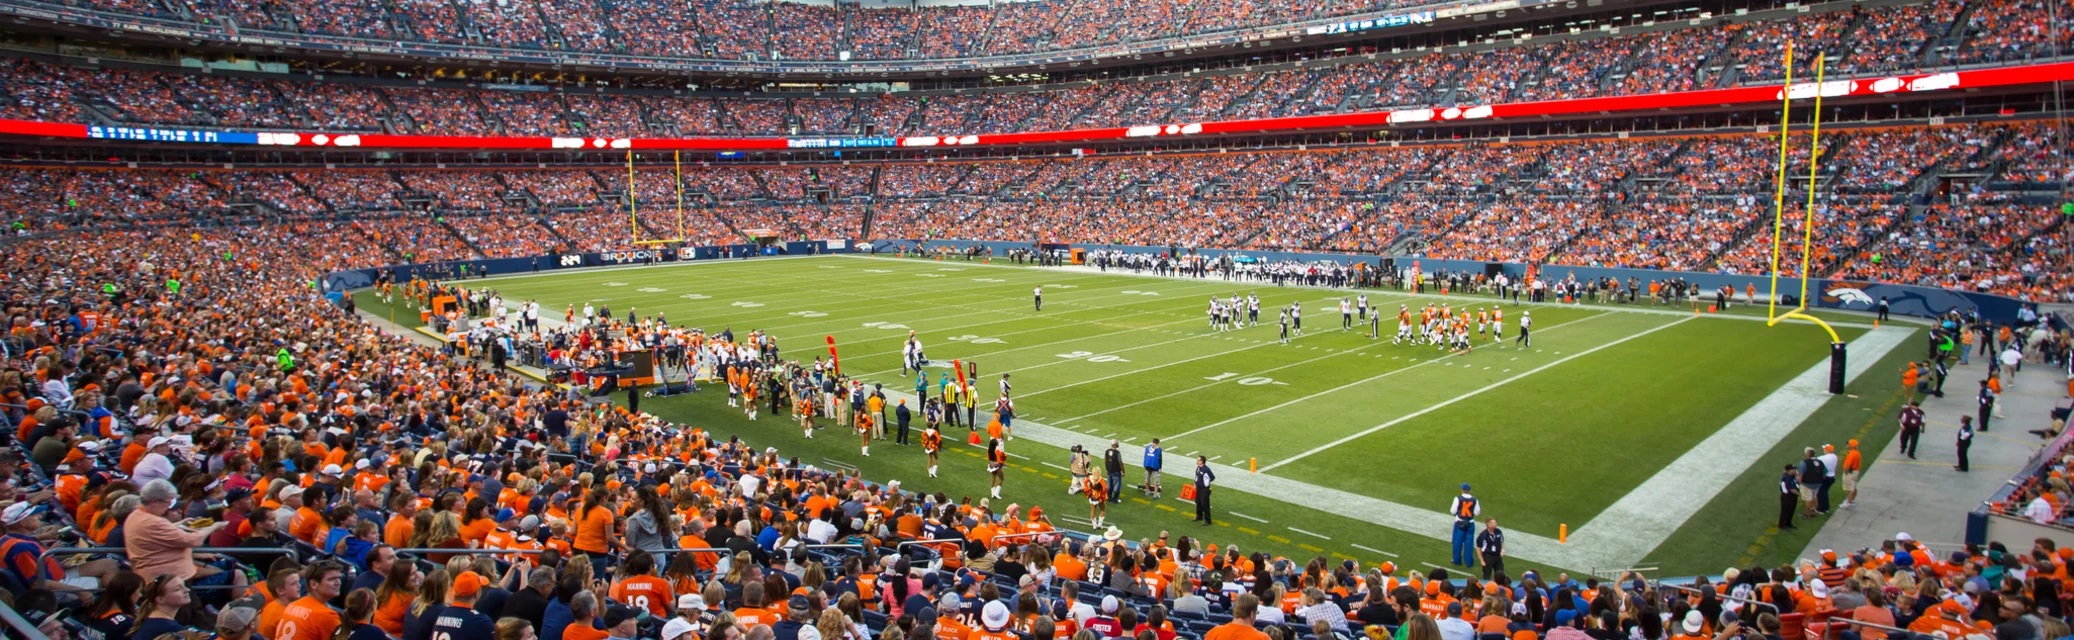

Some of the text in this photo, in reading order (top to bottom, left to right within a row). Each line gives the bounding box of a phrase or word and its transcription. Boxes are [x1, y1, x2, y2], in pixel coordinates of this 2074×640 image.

[123, 23, 141, 31] KARL
[142, 25, 191, 36] MECKLENBURG
[240, 36, 263, 44] DENNIS
[1055, 350, 1120, 362] 20
[1204, 371, 1275, 386] 10
[1461, 501, 1472, 517] K
[626, 582, 652, 591] MANNING
[627, 595, 650, 615] 18
[284, 604, 312, 620] MANNING
[110, 614, 126, 625] 18
[435, 616, 463, 629] MANNING
[275, 618, 297, 640] 18
[1092, 623, 1112, 632] FOSTER
